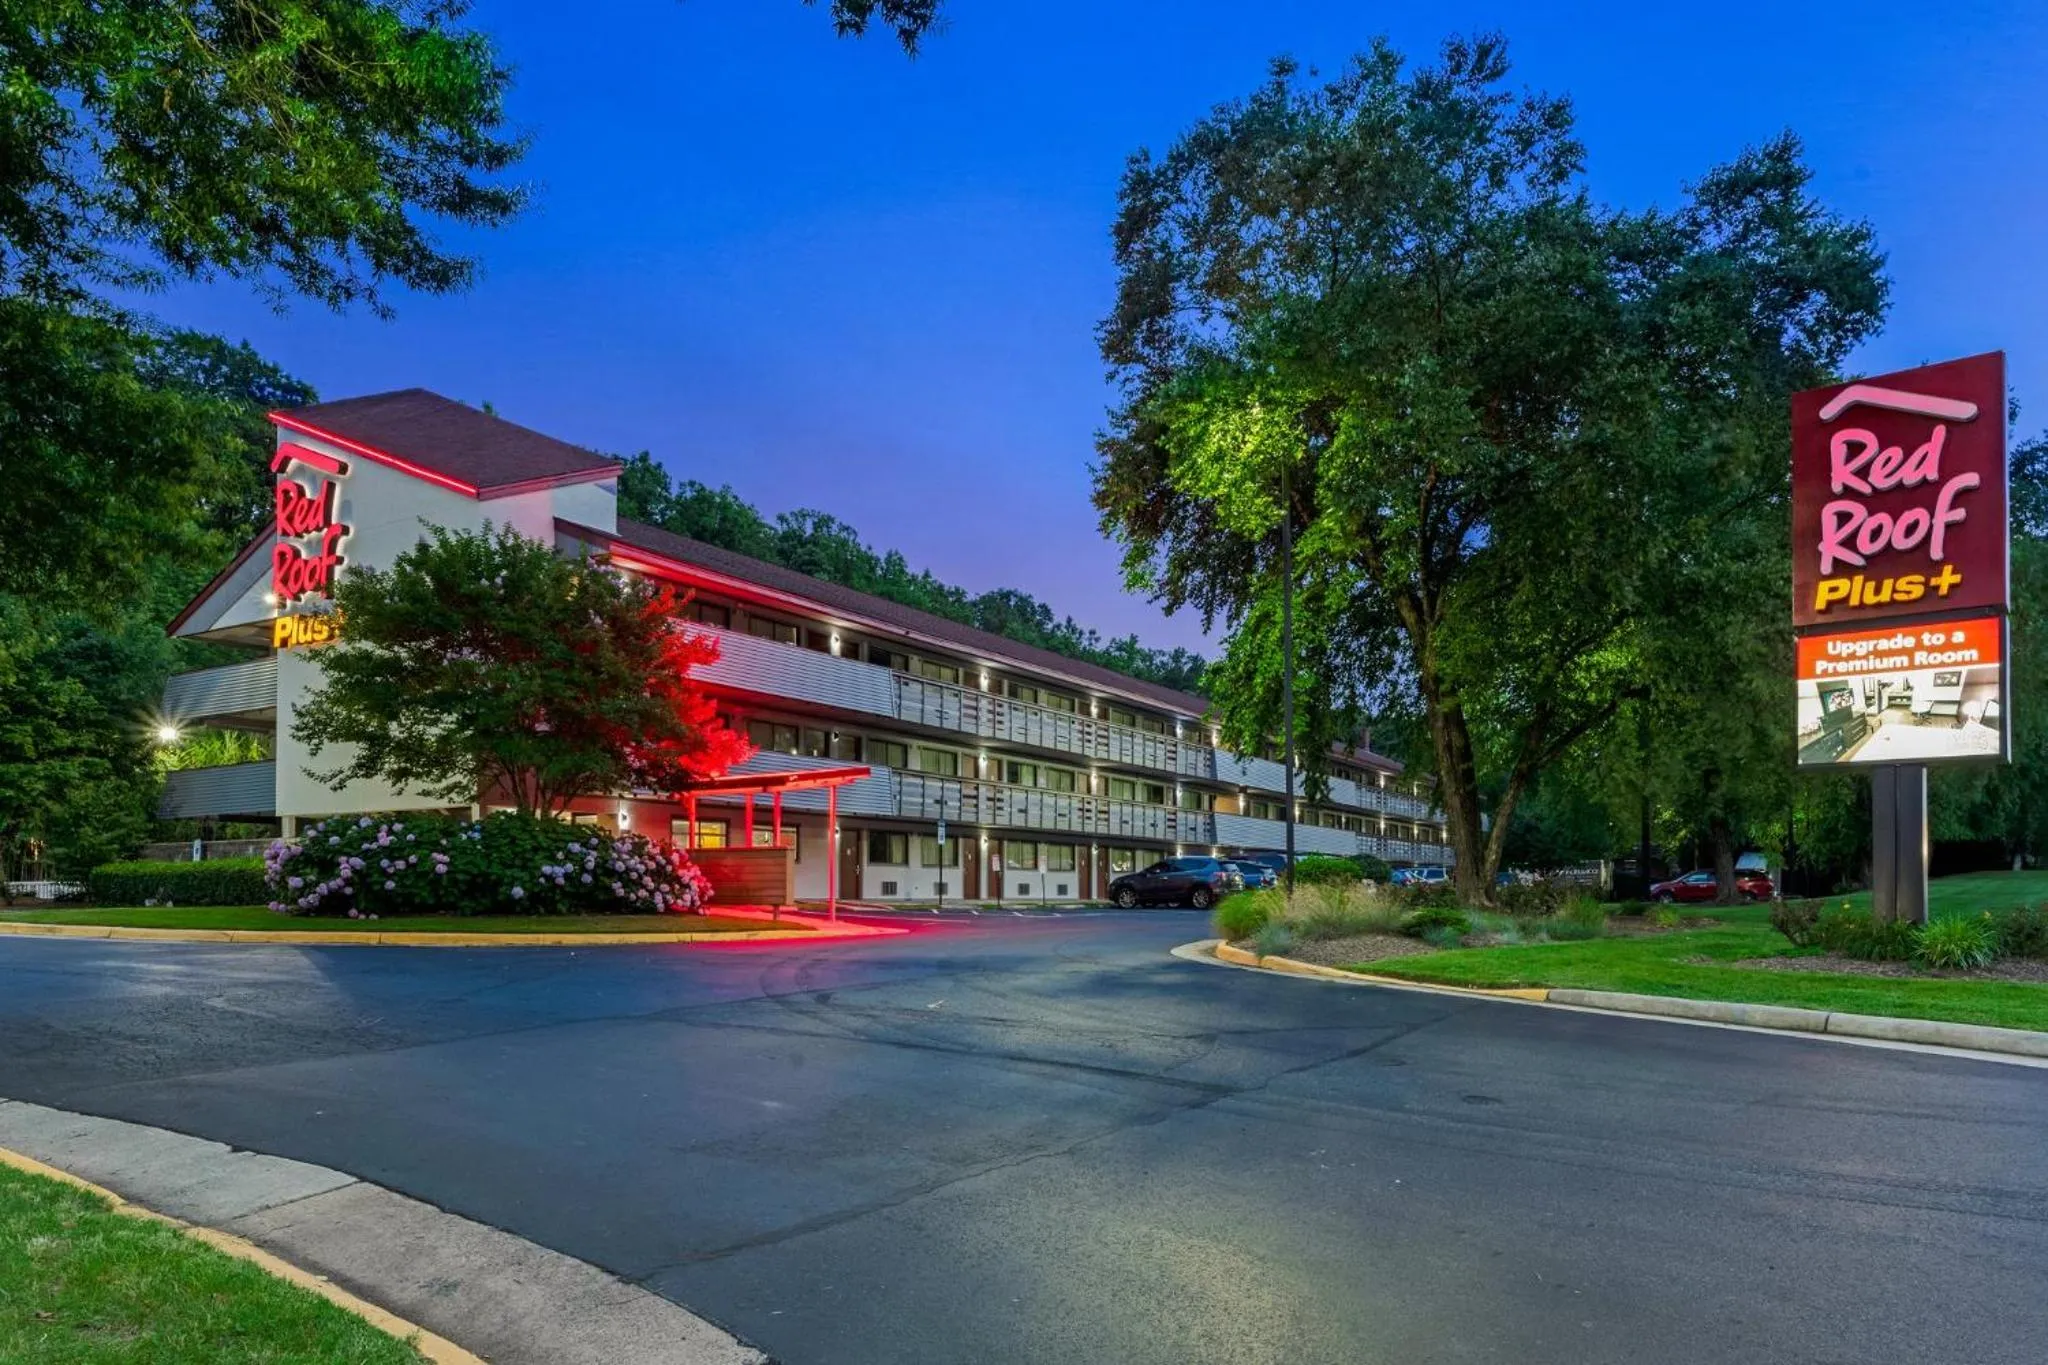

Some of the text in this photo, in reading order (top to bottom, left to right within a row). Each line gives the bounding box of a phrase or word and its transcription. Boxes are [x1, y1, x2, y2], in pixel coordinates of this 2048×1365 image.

[1830, 424, 1947, 496] Red
[276, 479, 331, 537] Red
[1818, 472, 1981, 577] Roof
[272, 523, 344, 603] Roof
[1814, 565, 1963, 612] Plus+
[1815, 648, 1979, 675] Premium Room
[1827, 630, 1965, 656] Upgrade to a
